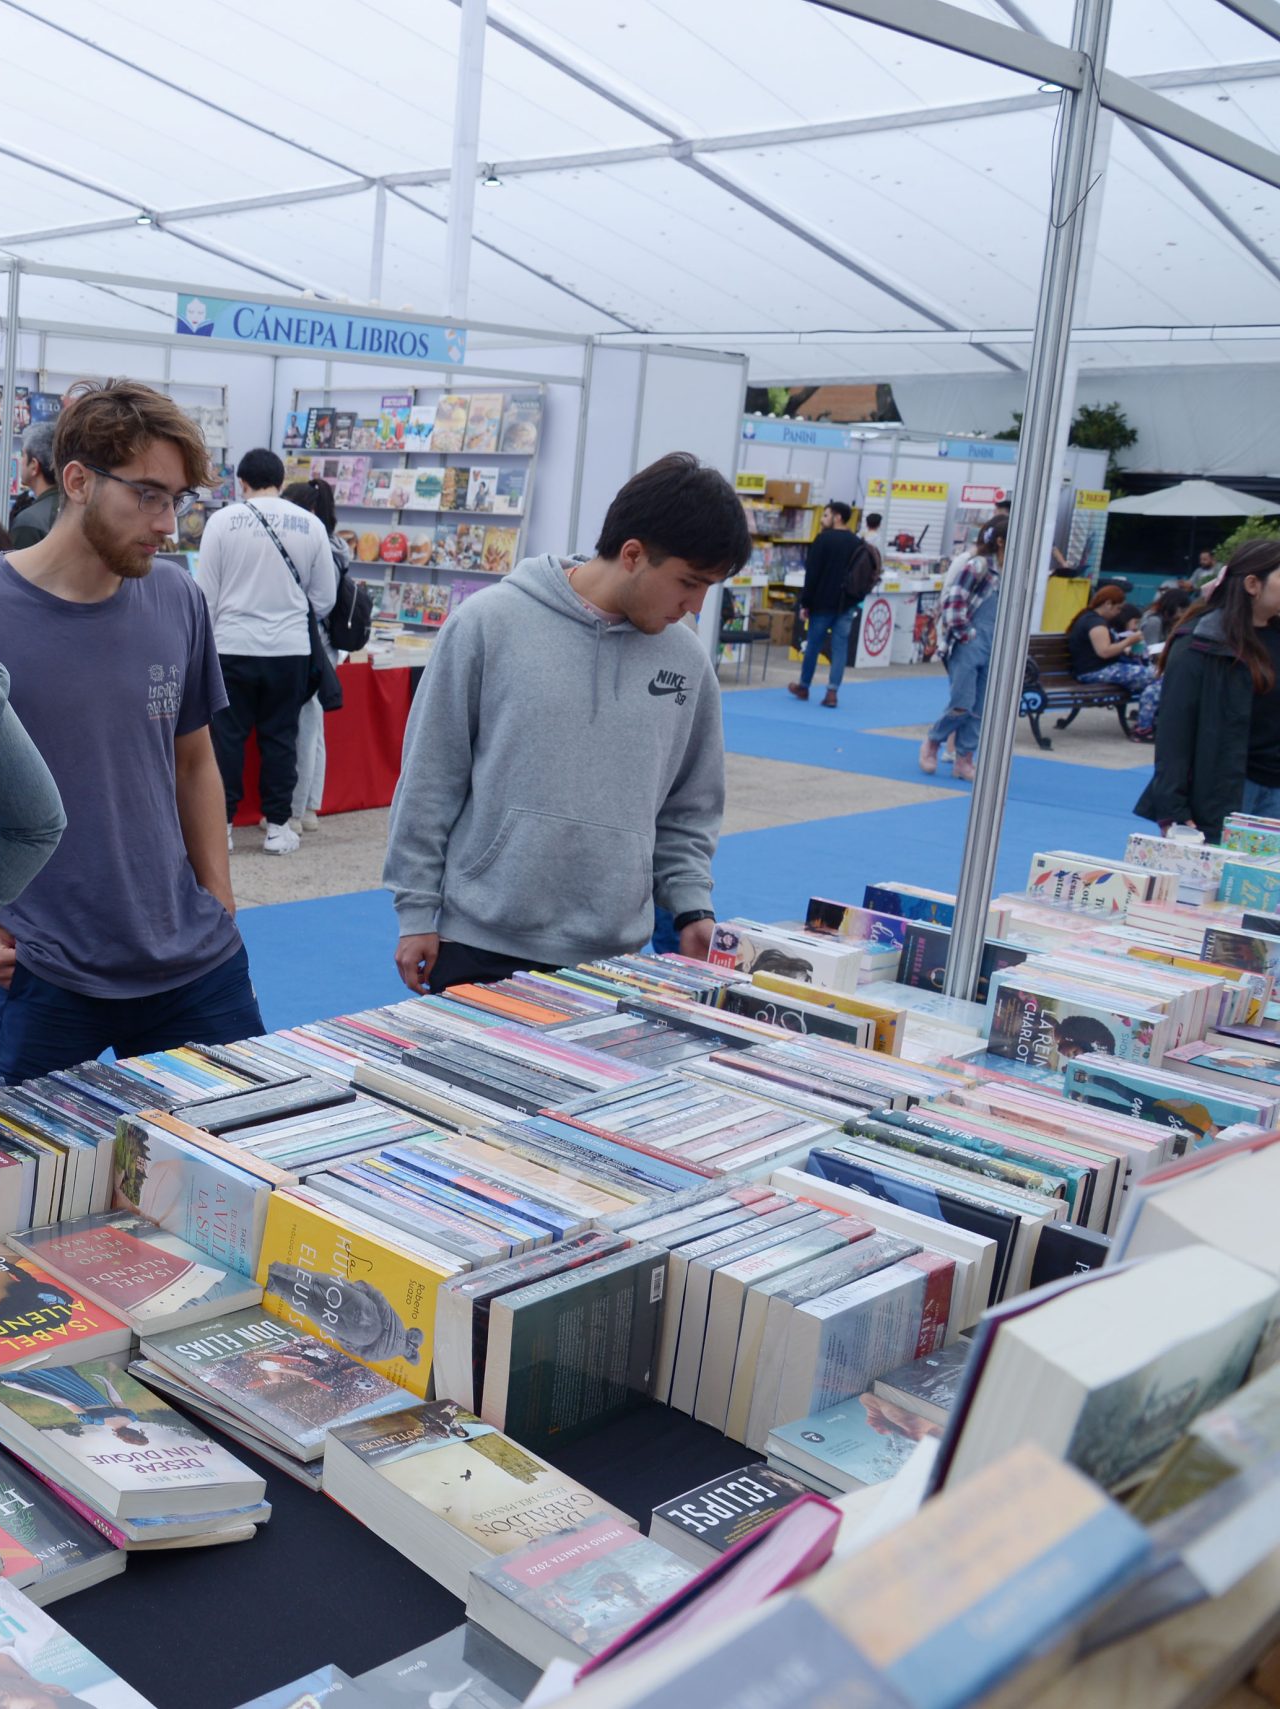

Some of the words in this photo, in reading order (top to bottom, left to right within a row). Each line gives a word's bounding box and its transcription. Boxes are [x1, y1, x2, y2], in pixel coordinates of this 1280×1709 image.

[233, 305, 337, 348] CÁNEPA
[346, 321, 429, 358] LIBROS
[305, 409, 318, 448] COCTELES
[783, 428, 816, 444] PANINI
[968, 446, 994, 458] PANINI
[891, 483, 943, 494] PANINI
[656, 669, 686, 689] NIKE
[675, 692, 686, 705] SB
[1036, 1009, 1053, 1030] LA
[1015, 1003, 1035, 1064] CHARLOT
[198, 1189, 207, 1209] LA
[216, 1182, 225, 1203] LA
[88, 1230, 111, 1243] DE
[212, 1204, 225, 1258] VILL
[50, 1236, 85, 1251] MAR
[79, 1246, 132, 1266] LARGO
[86, 1256, 167, 1285] ALLENDE
[110, 1267, 174, 1290] ISABEL
[290, 1244, 315, 1326] ELEUSIS
[405, 1279, 416, 1304] Suazo
[412, 1283, 425, 1318] Roberto
[0, 1316, 98, 1352] ISABEL
[235, 1319, 286, 1345] DON
[200, 1444, 212, 1453] A
[355, 1426, 424, 1452] OUTLANDER
[86, 1449, 157, 1464] DUQUE
[162, 1445, 195, 1457] UN
[128, 1457, 203, 1474] DESEAR
[514, 1495, 535, 1509] DEL
[536, 1484, 567, 1502] ECOS
[472, 1501, 515, 1523] PASADO
[473, 1488, 594, 1539] GABALDON
[667, 1475, 777, 1533] ECLIPSE
[514, 1510, 587, 1542] DIANA
[46, 1537, 75, 1555] Yuval
[589, 1527, 623, 1548] PREMIO
[550, 1541, 589, 1566] PLANETA
[525, 1559, 550, 1577] 2022
